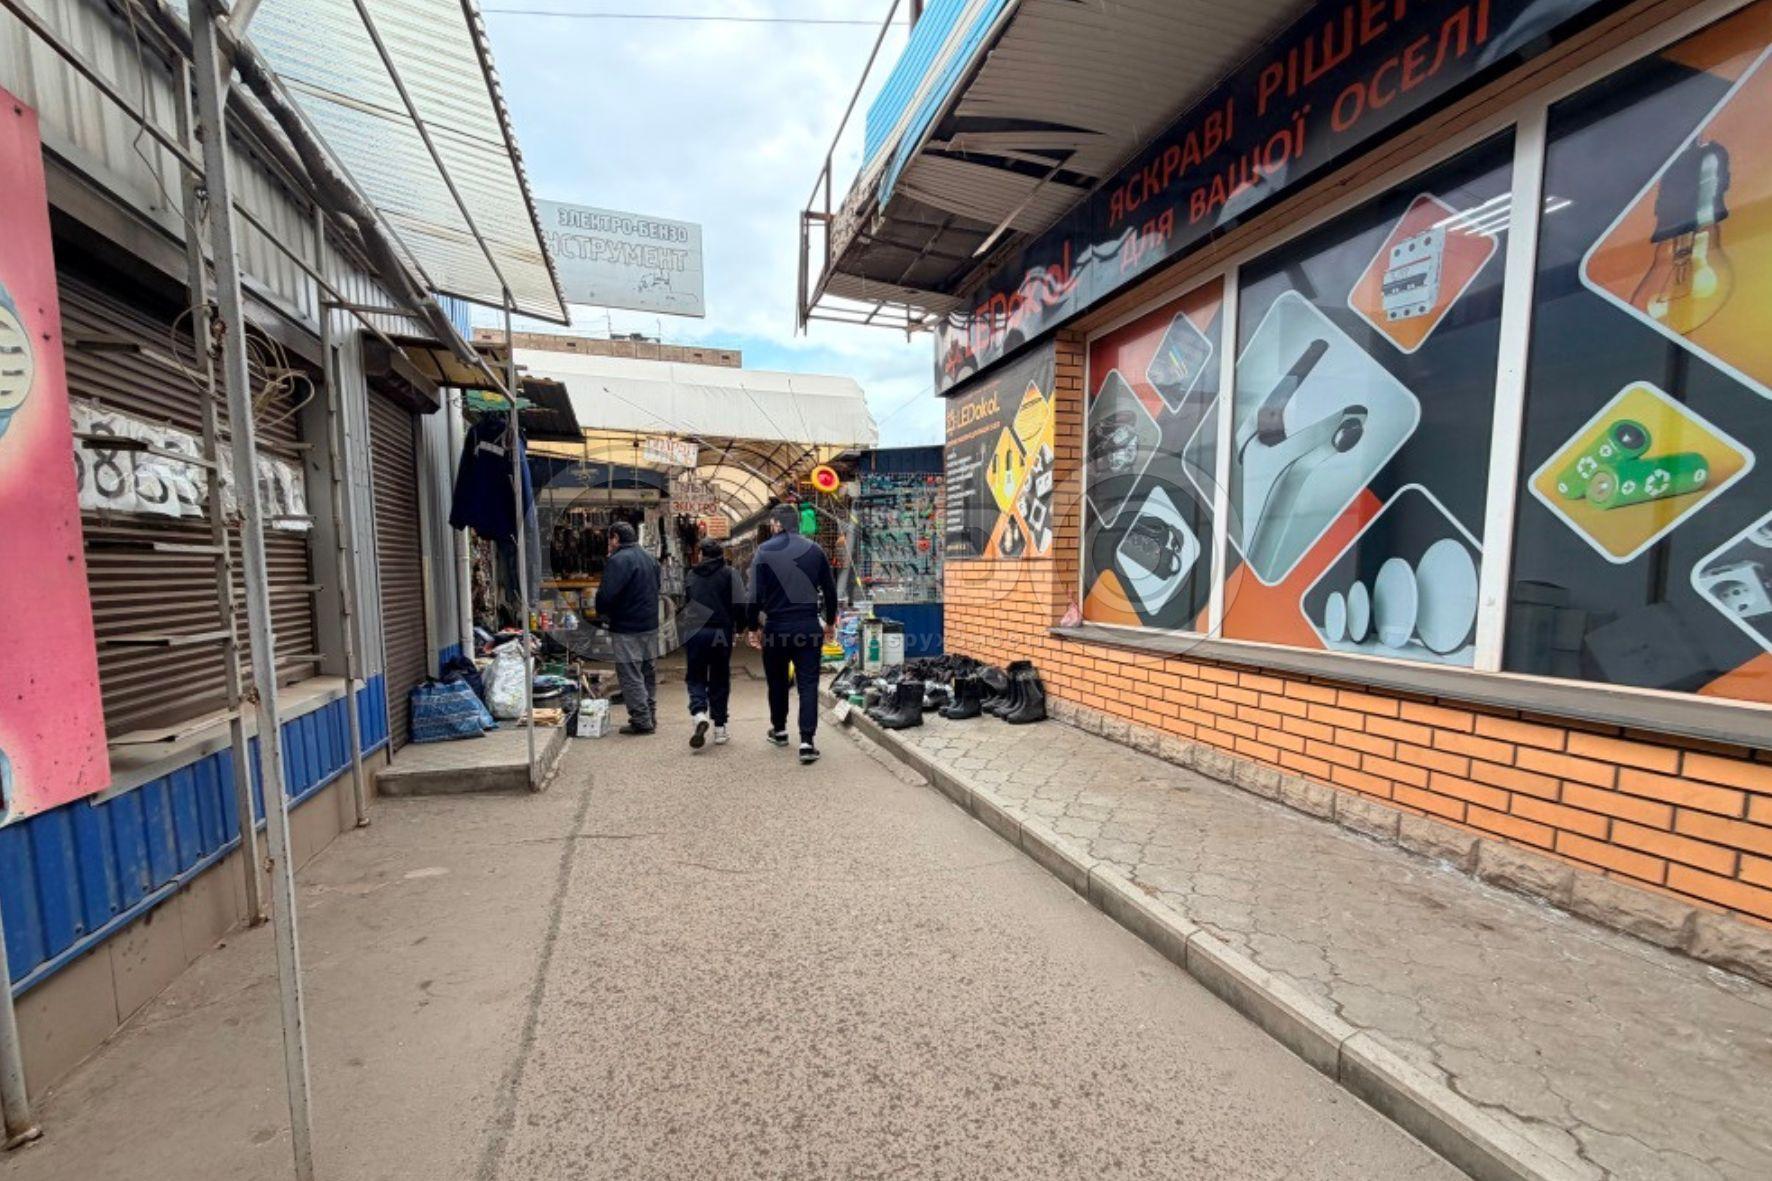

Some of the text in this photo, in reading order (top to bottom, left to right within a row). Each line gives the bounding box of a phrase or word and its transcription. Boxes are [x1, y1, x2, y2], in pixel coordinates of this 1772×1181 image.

[1109, 97, 1234, 229] ЯСКРАВІ
[1120, 0, 1491, 275] ДЛЯ ВАШОЇ ОСЕЛІ
[545, 230, 688, 272] НСТРУМЕНТ
